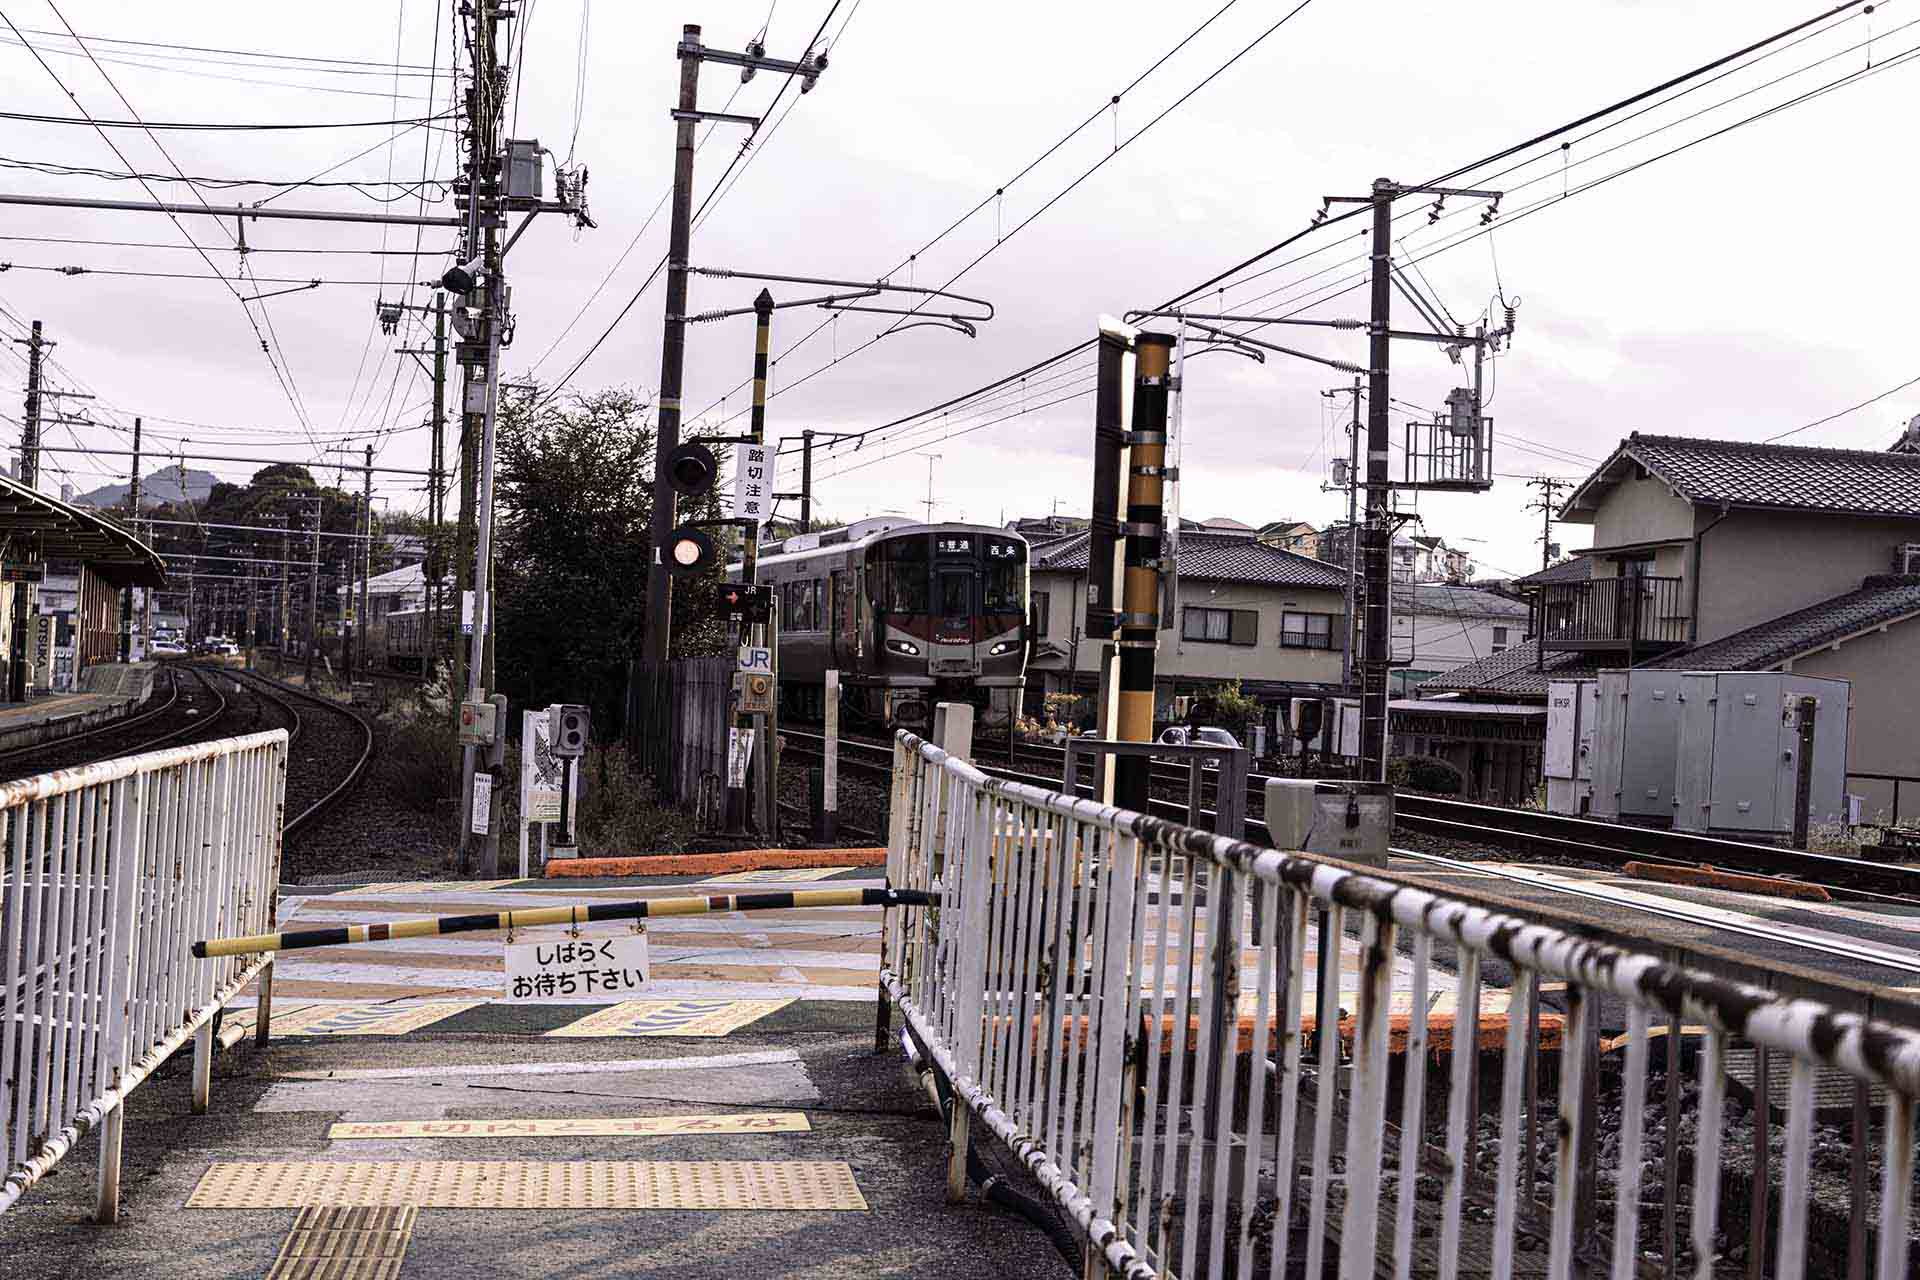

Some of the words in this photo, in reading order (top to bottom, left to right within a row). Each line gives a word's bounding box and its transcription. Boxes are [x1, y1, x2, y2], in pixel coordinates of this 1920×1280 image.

[744, 449, 765, 514] 踏切注意
[744, 585, 757, 595] JR
[38, 615, 49, 669] OTSUKA
[740, 650, 769, 668] JR
[536, 939, 616, 966] しばらく
[512, 967, 644, 998] お待ち下さい
